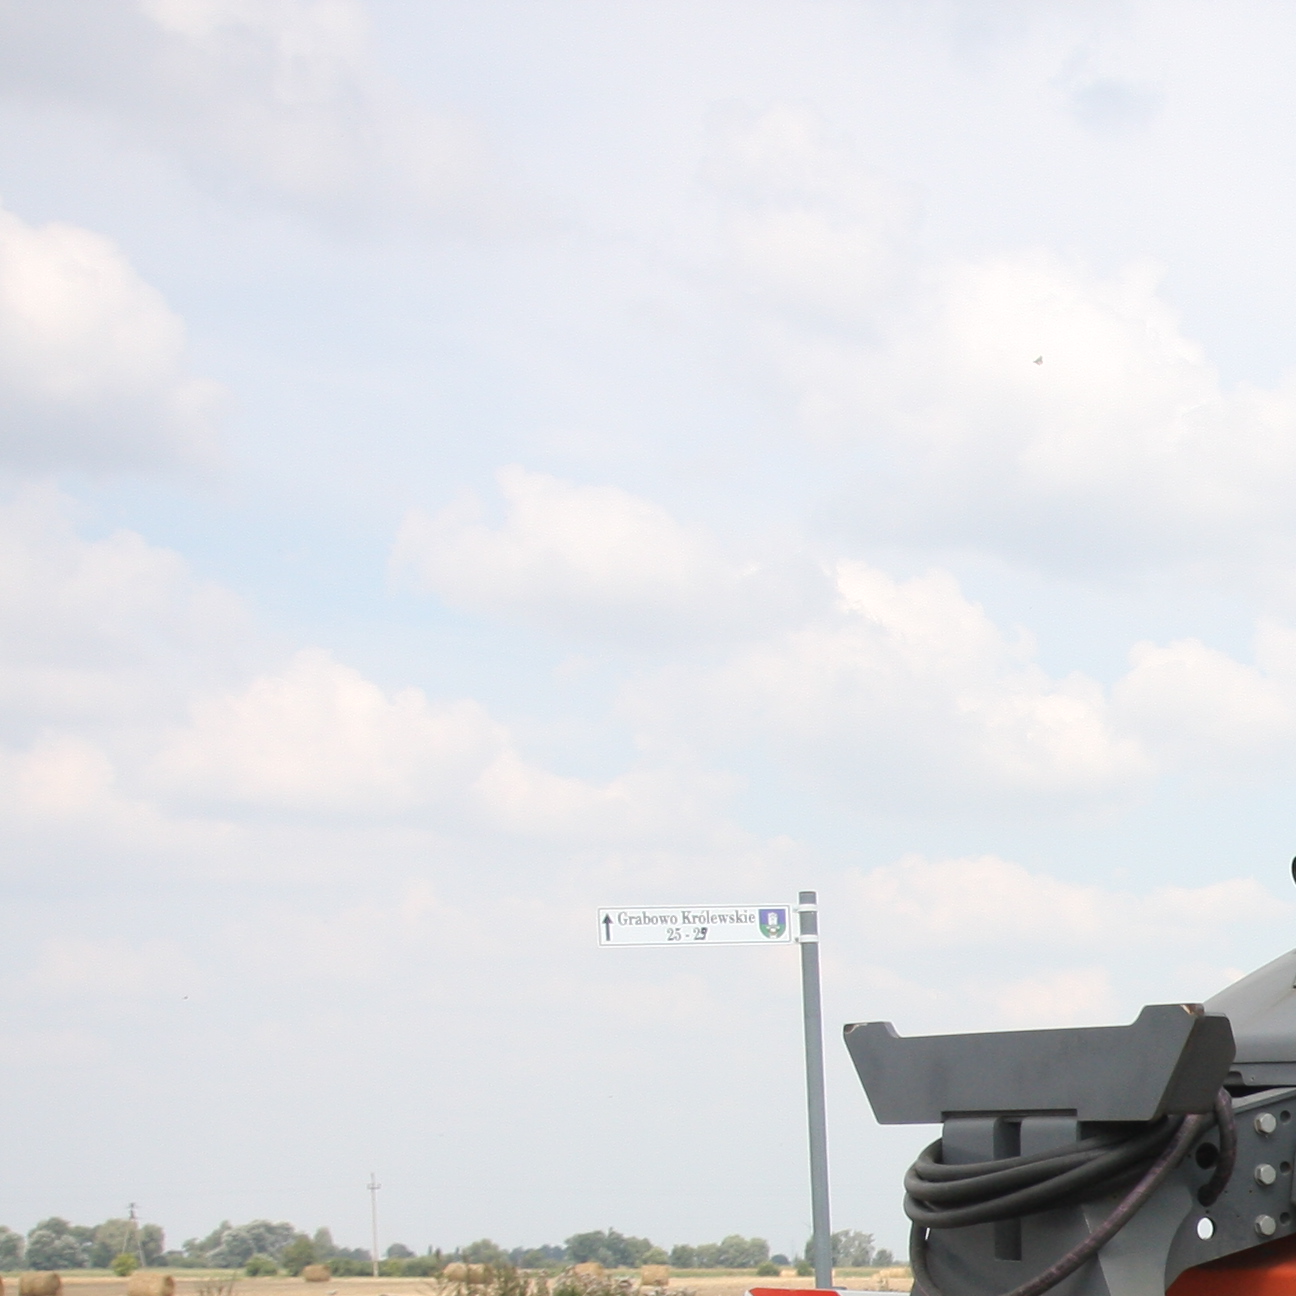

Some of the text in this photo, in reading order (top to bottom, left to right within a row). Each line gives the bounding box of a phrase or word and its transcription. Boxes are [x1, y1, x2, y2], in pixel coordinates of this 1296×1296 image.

[617, 909, 756, 926] Grabowo Królewskie
[667, 927, 682, 941] 25
